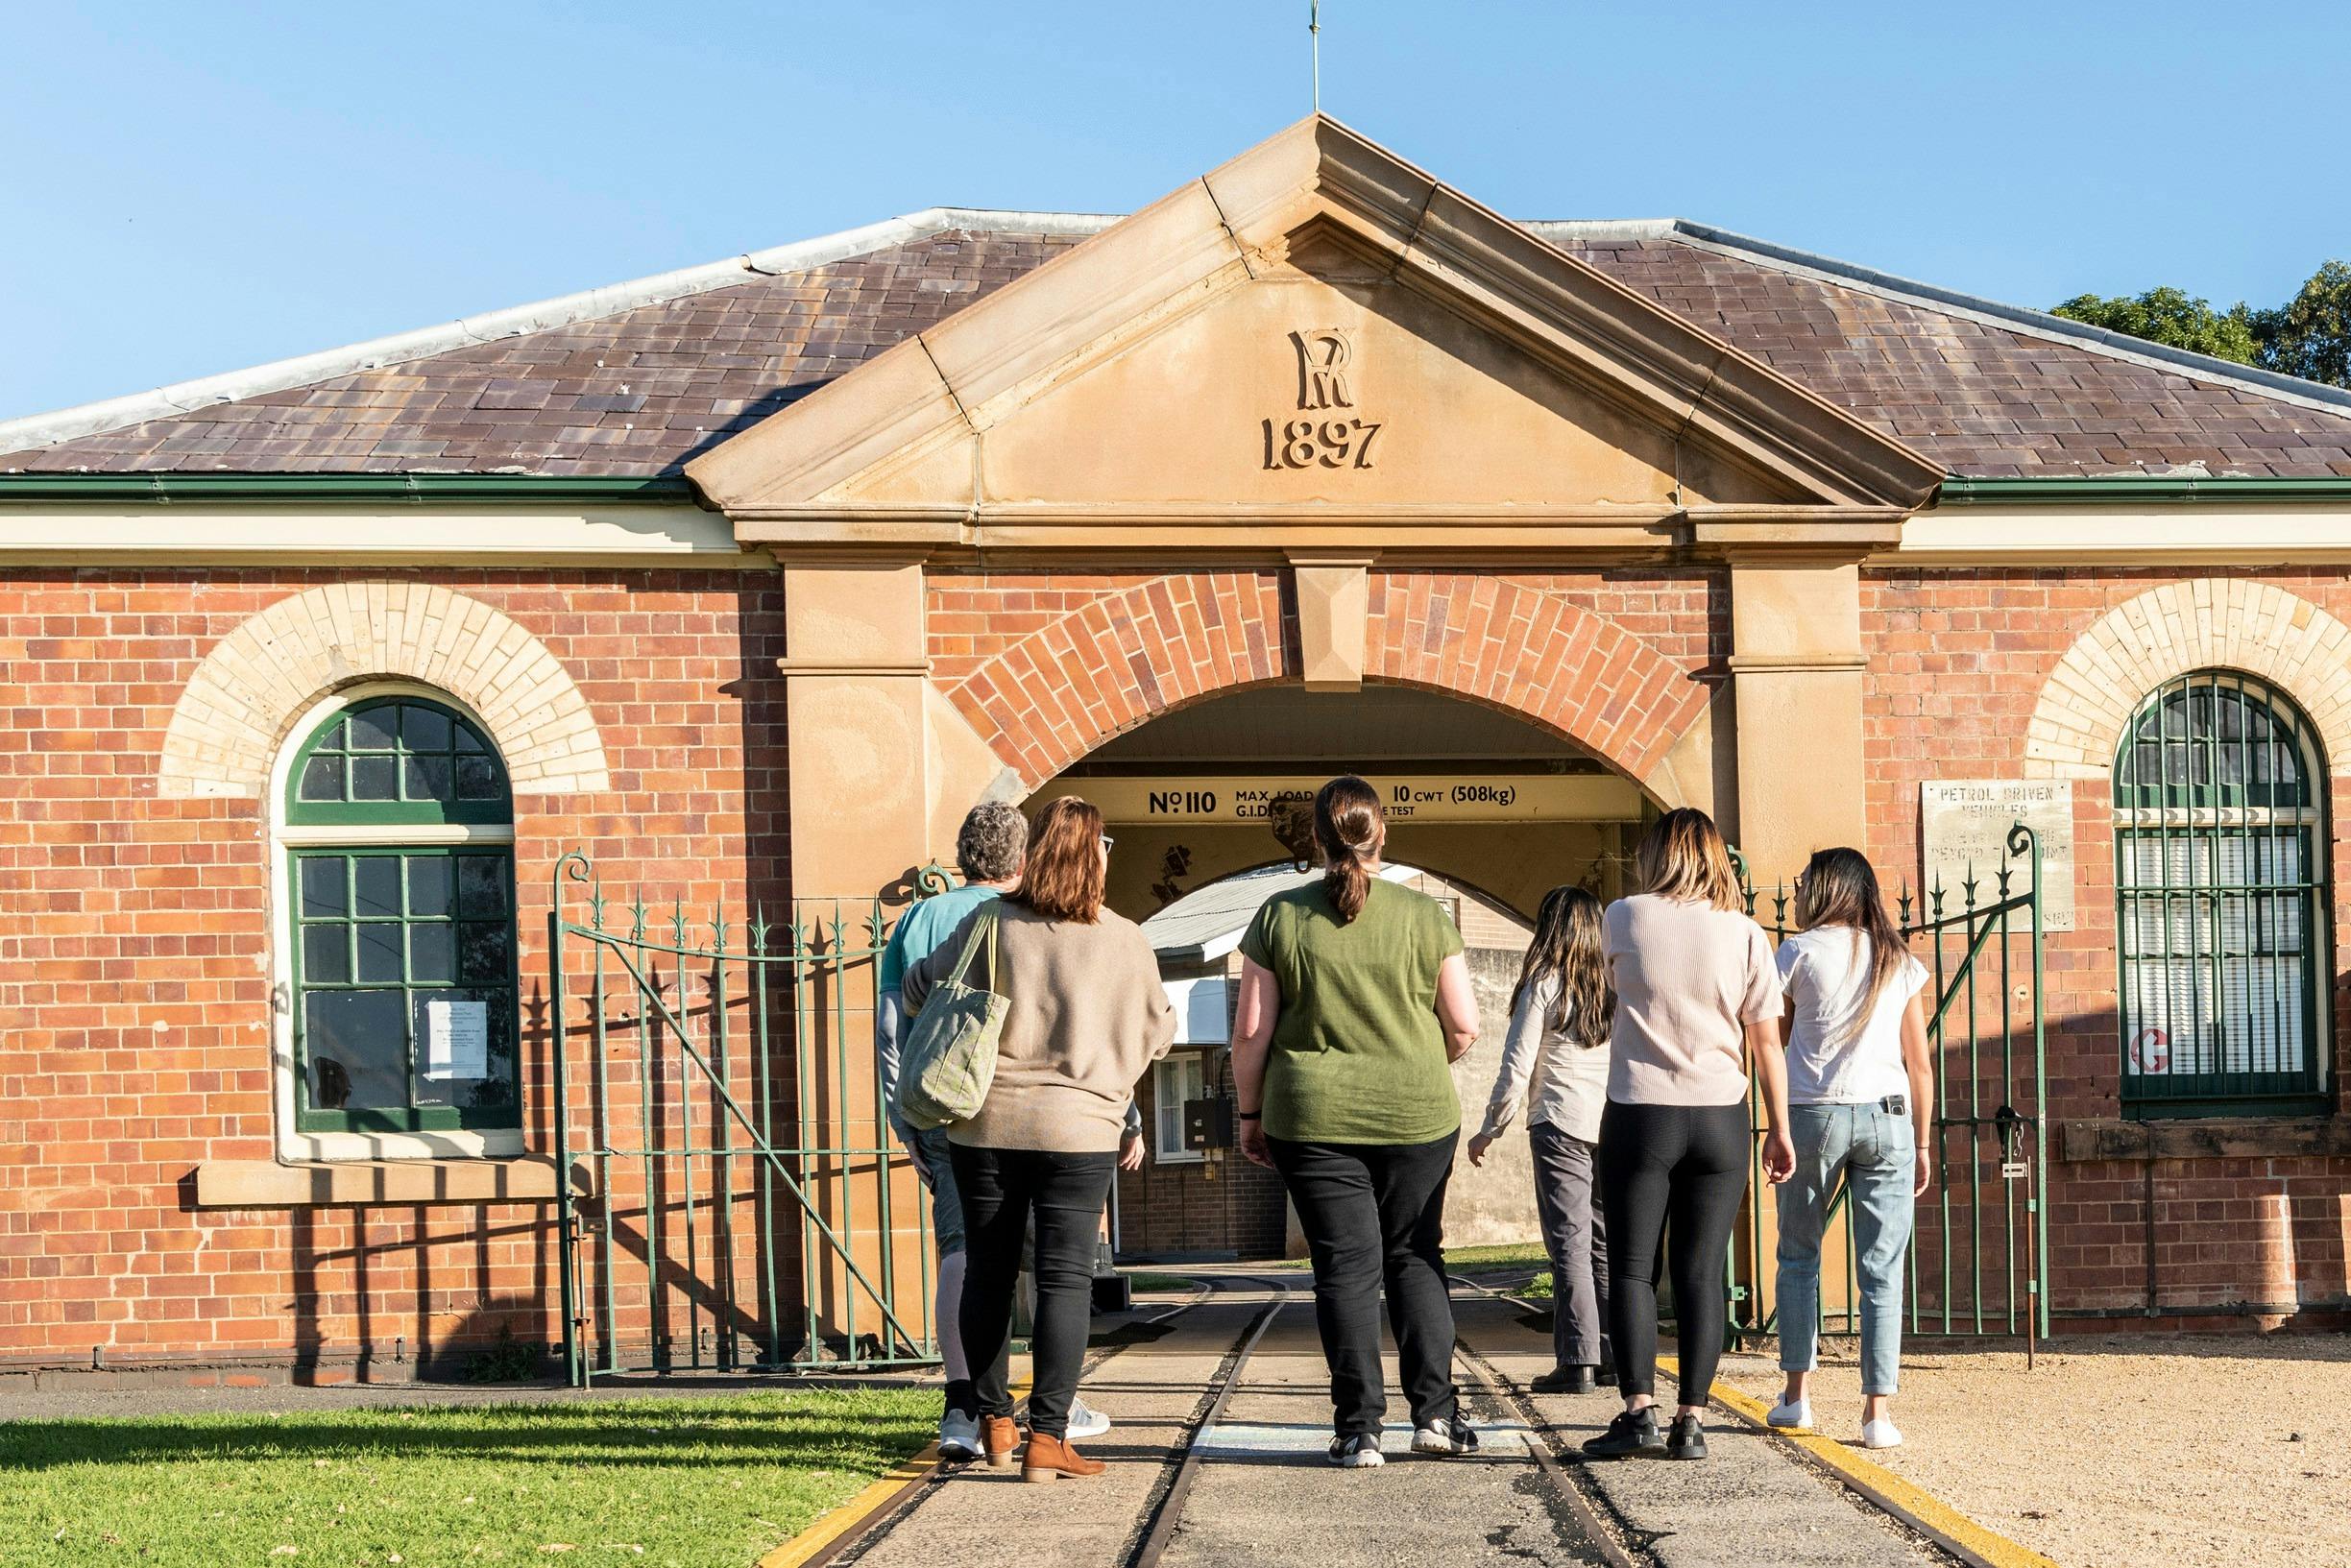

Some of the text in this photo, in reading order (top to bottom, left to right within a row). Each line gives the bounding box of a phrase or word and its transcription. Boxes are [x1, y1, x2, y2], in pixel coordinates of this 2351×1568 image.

[1261, 417, 1388, 470] 1897
[1186, 791, 1217, 813] 110
[1394, 785, 1410, 803] 10
[1414, 791, 1444, 802] CWT
[1451, 785, 1515, 806] (508kg)
[1940, 787, 1995, 802] PETROL
[1391, 806, 1415, 815] TEST
